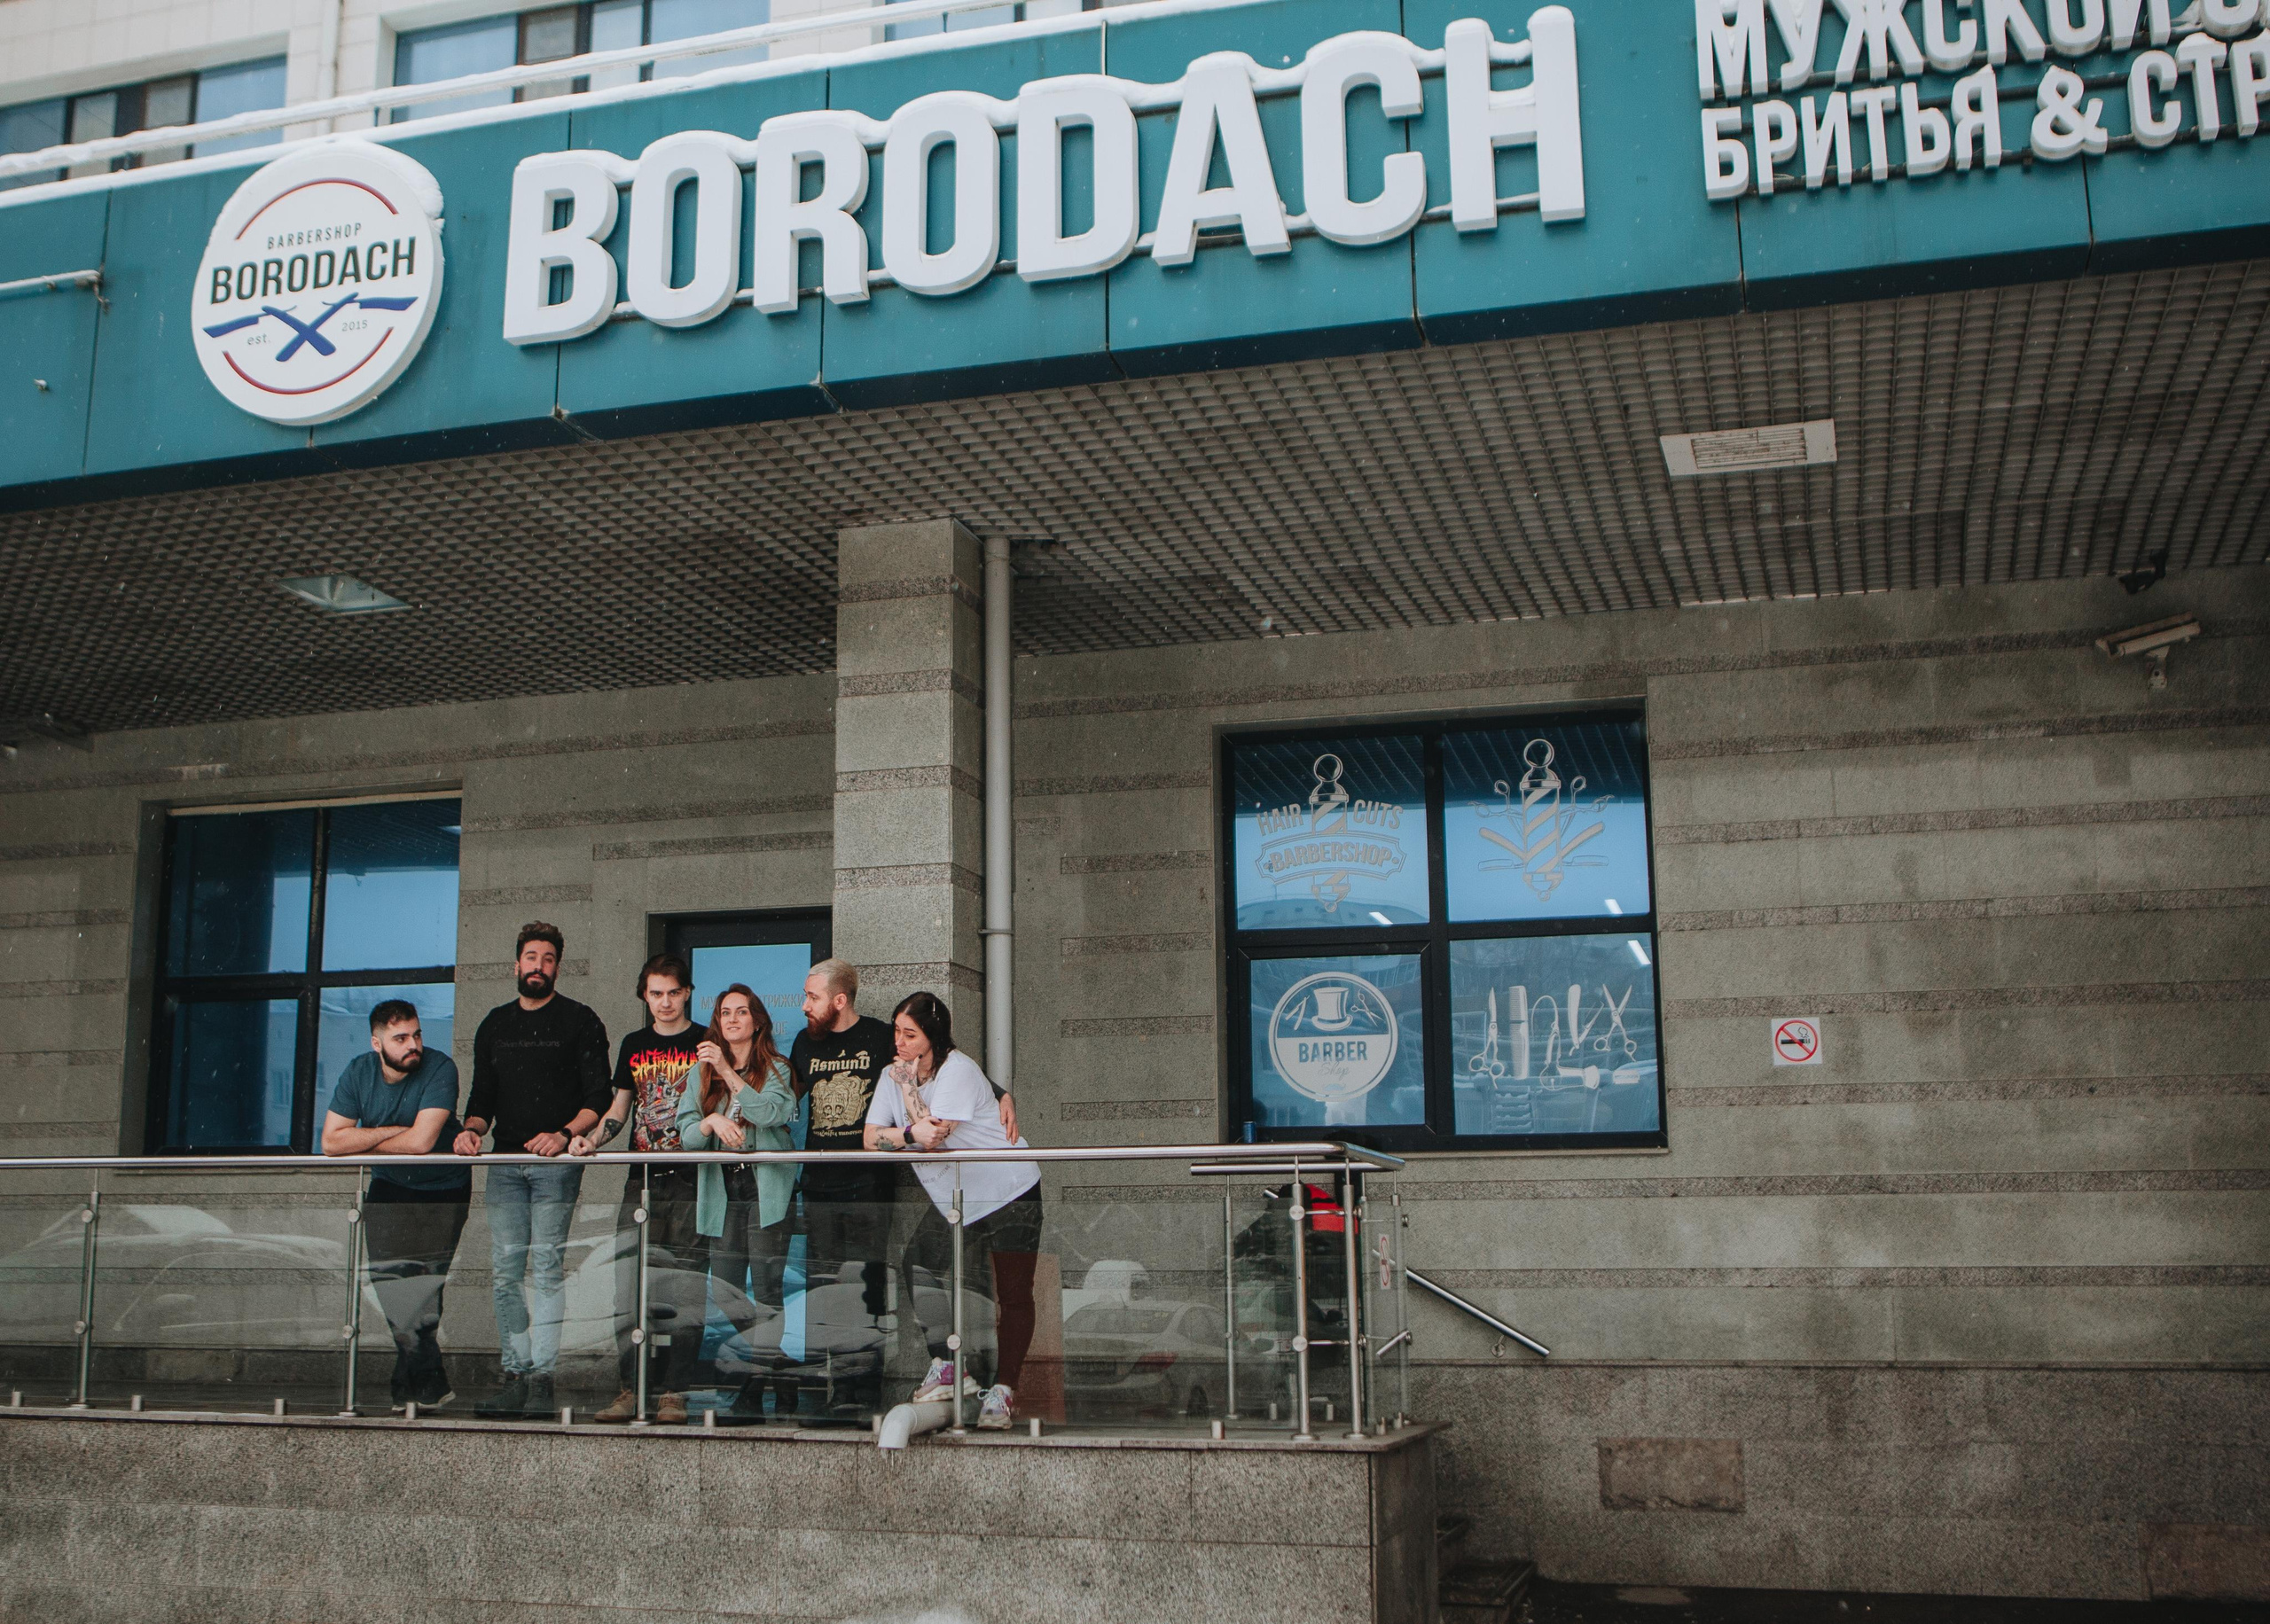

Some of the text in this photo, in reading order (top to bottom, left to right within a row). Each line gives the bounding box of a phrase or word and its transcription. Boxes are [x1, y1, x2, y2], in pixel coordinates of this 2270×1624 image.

[1700, 64, 2002, 201] БРИТЬЯ
[2030, 64, 2108, 160] &
[502, 4, 1587, 347] BORODACH
[266, 222, 362, 250] BARBERSHOP
[210, 235, 417, 305] BORODACH
[247, 319, 368, 346] est. 2015
[1256, 799, 1404, 836] HAIR CUTS
[1269, 841, 1393, 873] BARBERSHOP
[1298, 1041, 1368, 1063] BARBER
